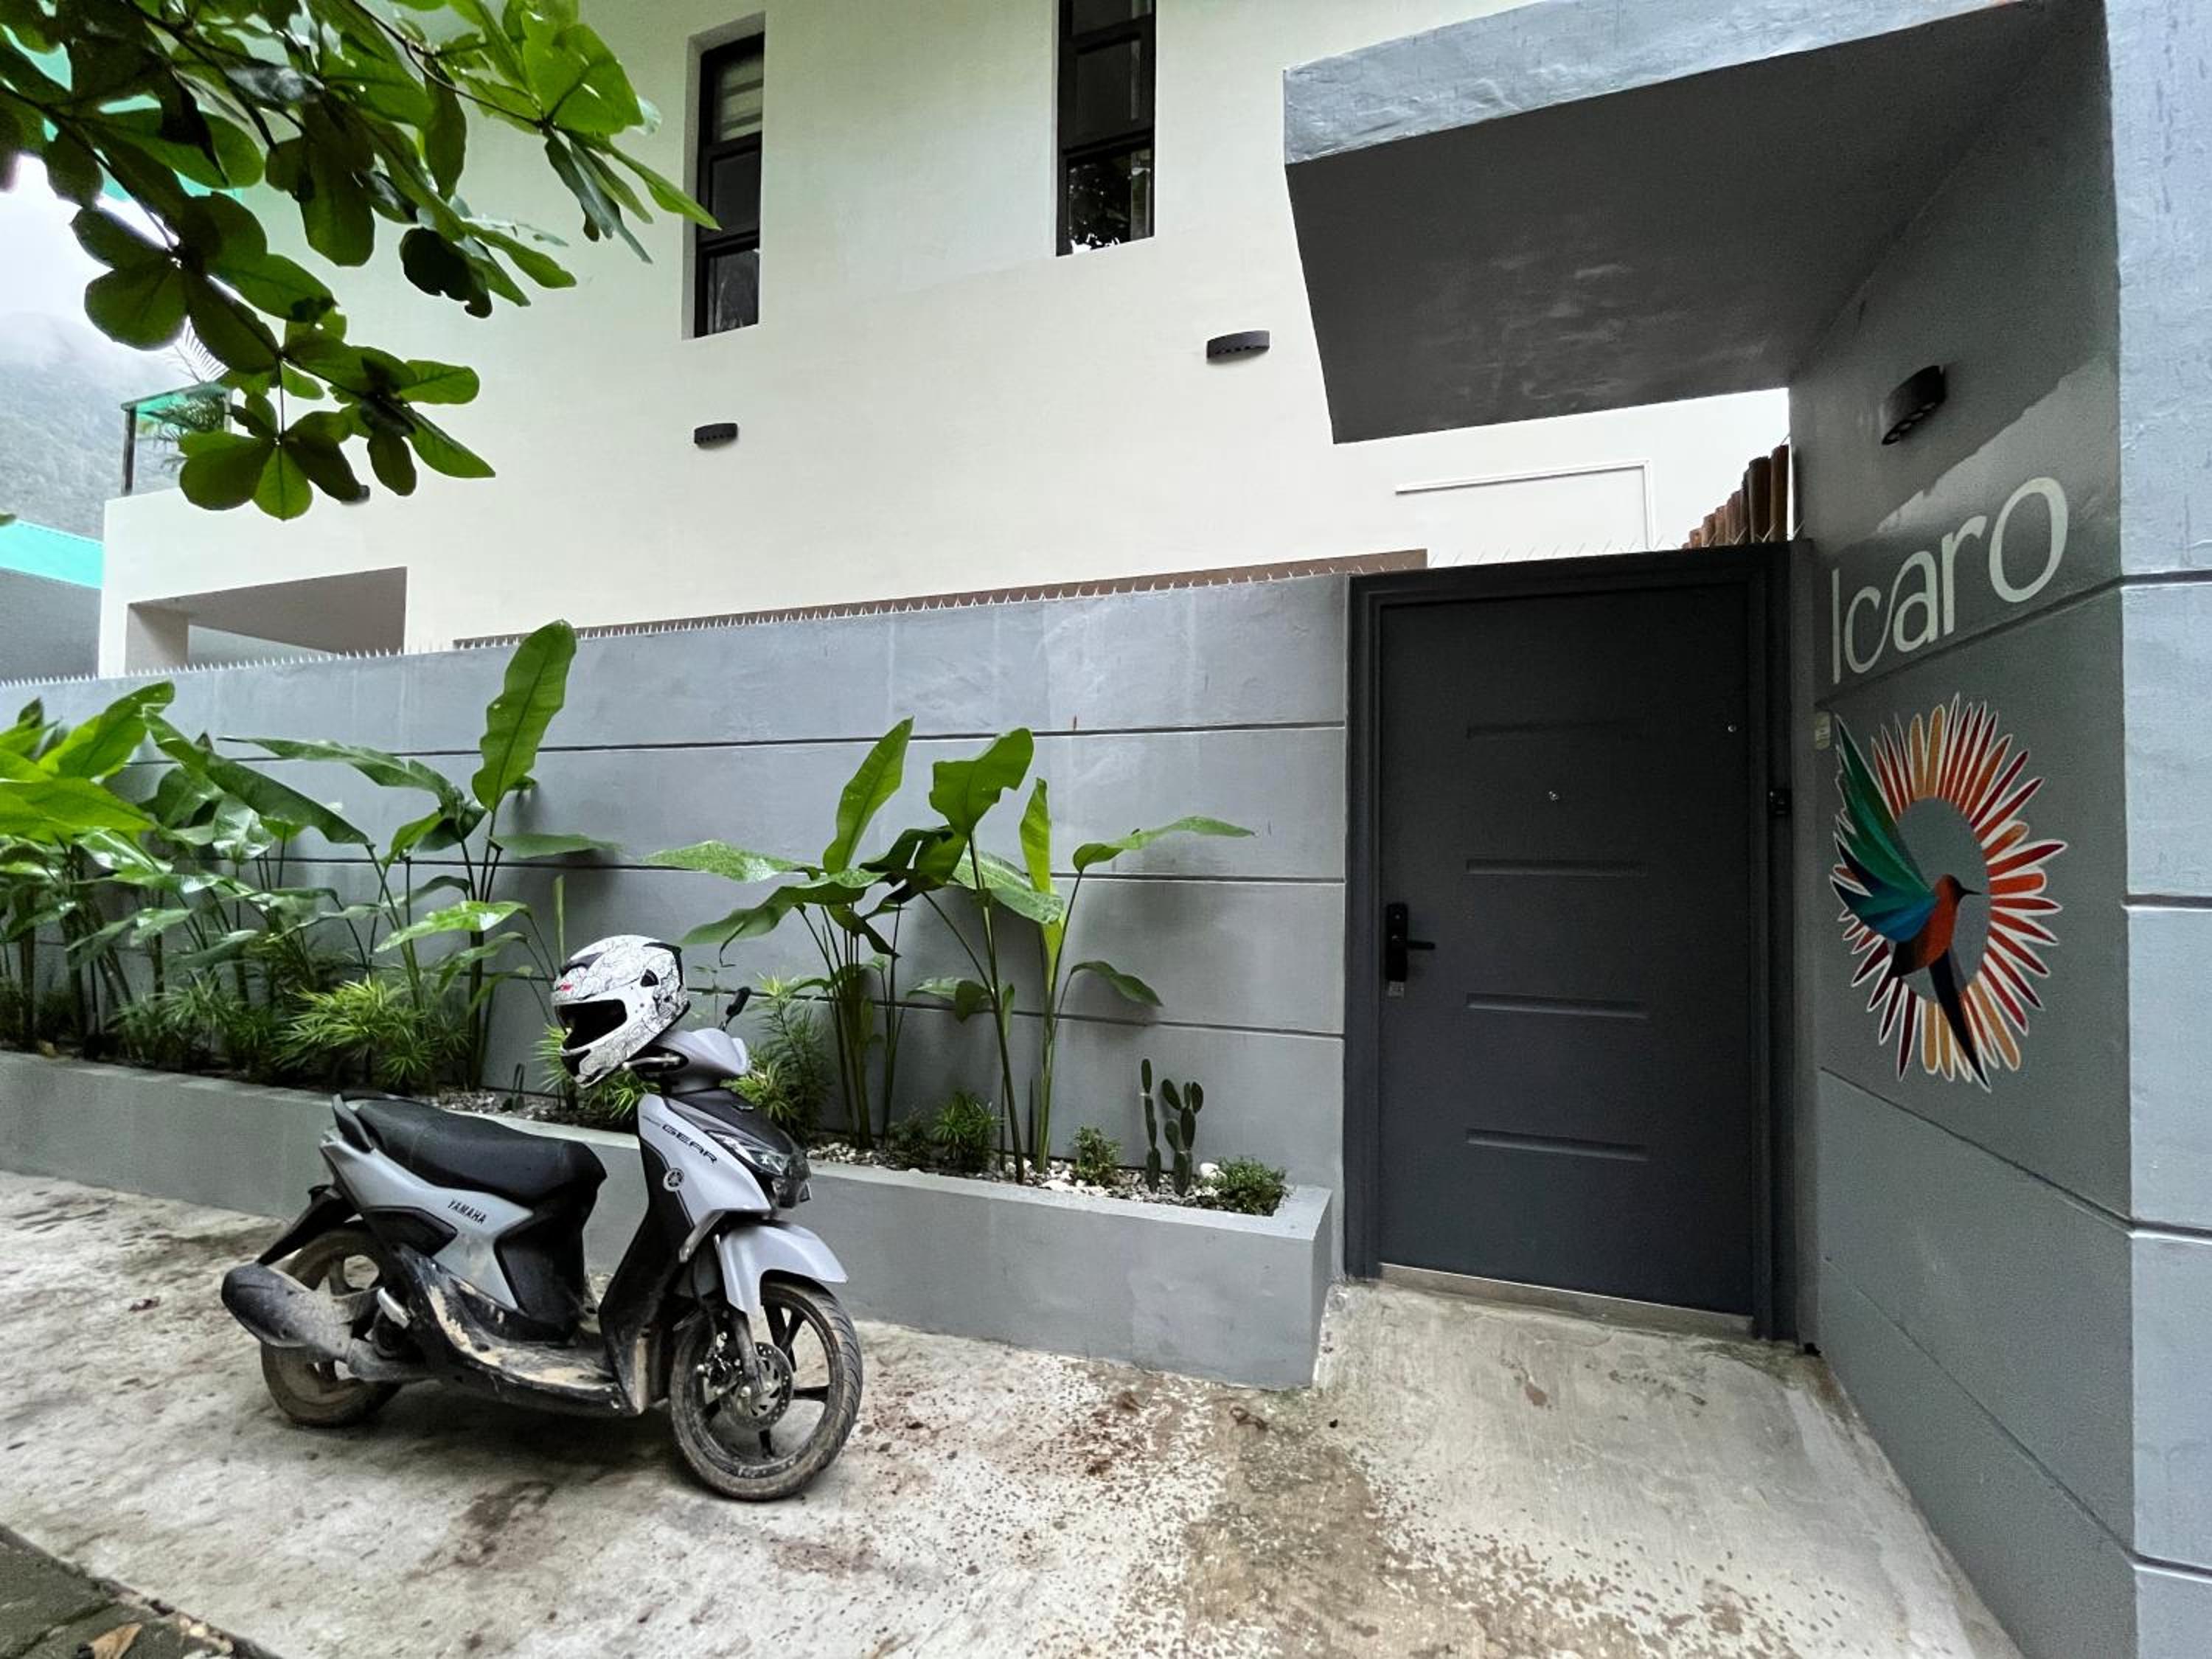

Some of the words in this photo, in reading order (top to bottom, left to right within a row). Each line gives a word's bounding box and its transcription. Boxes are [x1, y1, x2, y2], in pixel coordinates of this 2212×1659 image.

[1832, 477, 2068, 684] Icaro
[662, 1124, 717, 1164] GEAR
[448, 1200, 487, 1225] YAMAHA
